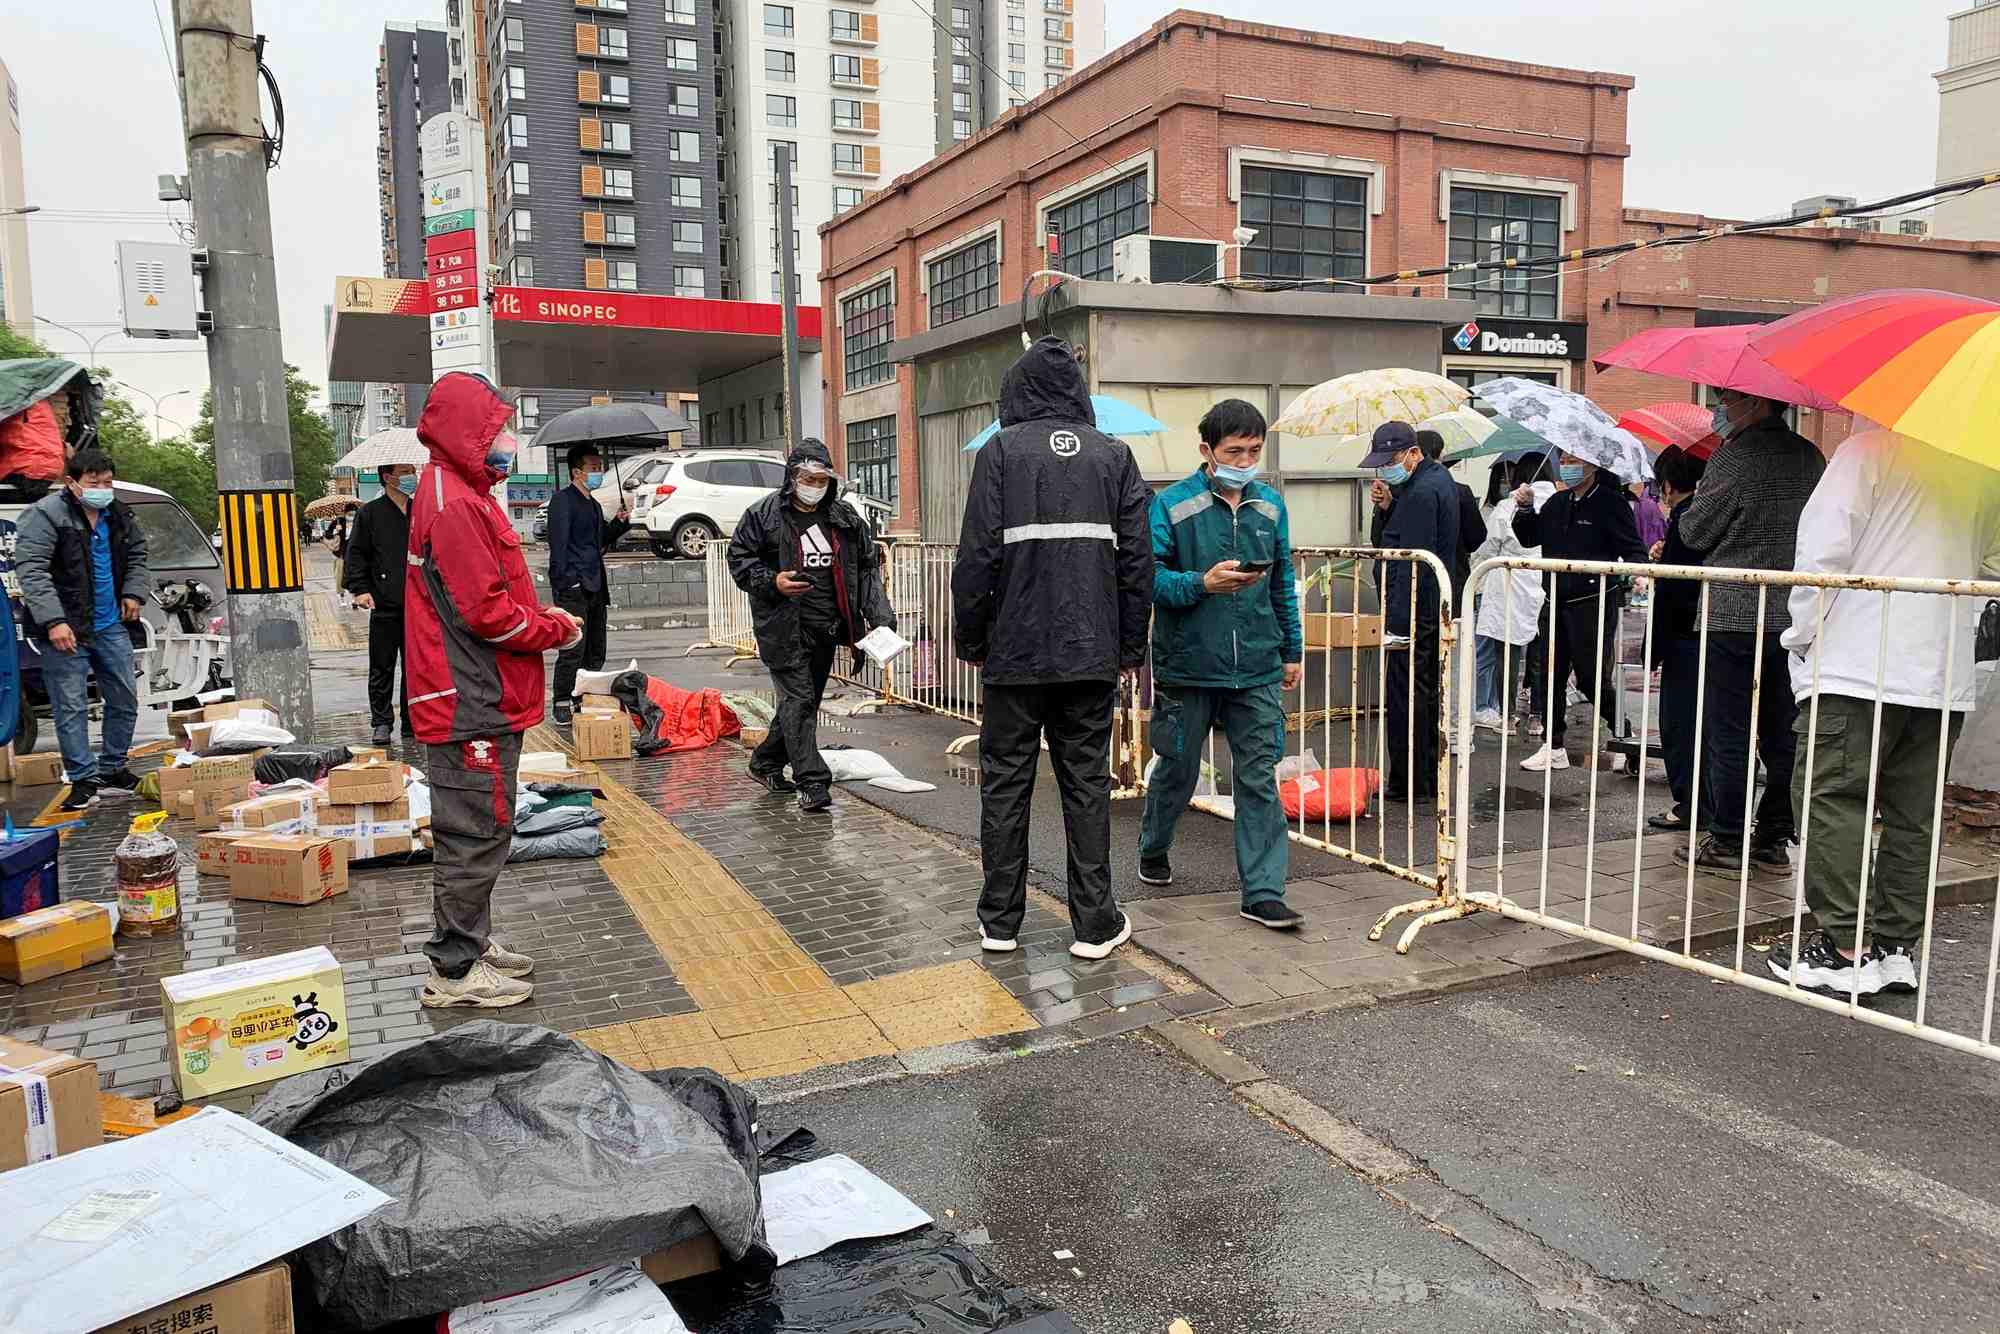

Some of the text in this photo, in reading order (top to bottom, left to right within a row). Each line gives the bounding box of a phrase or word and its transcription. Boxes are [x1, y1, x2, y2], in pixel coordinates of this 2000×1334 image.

[495, 293, 521, 314] 化
[538, 302, 617, 320] SINOPEC
[1481, 331, 1568, 355] Domino's
[1055, 436, 1074, 450] SF
[231, 1015, 295, 1039] 法式小面包
